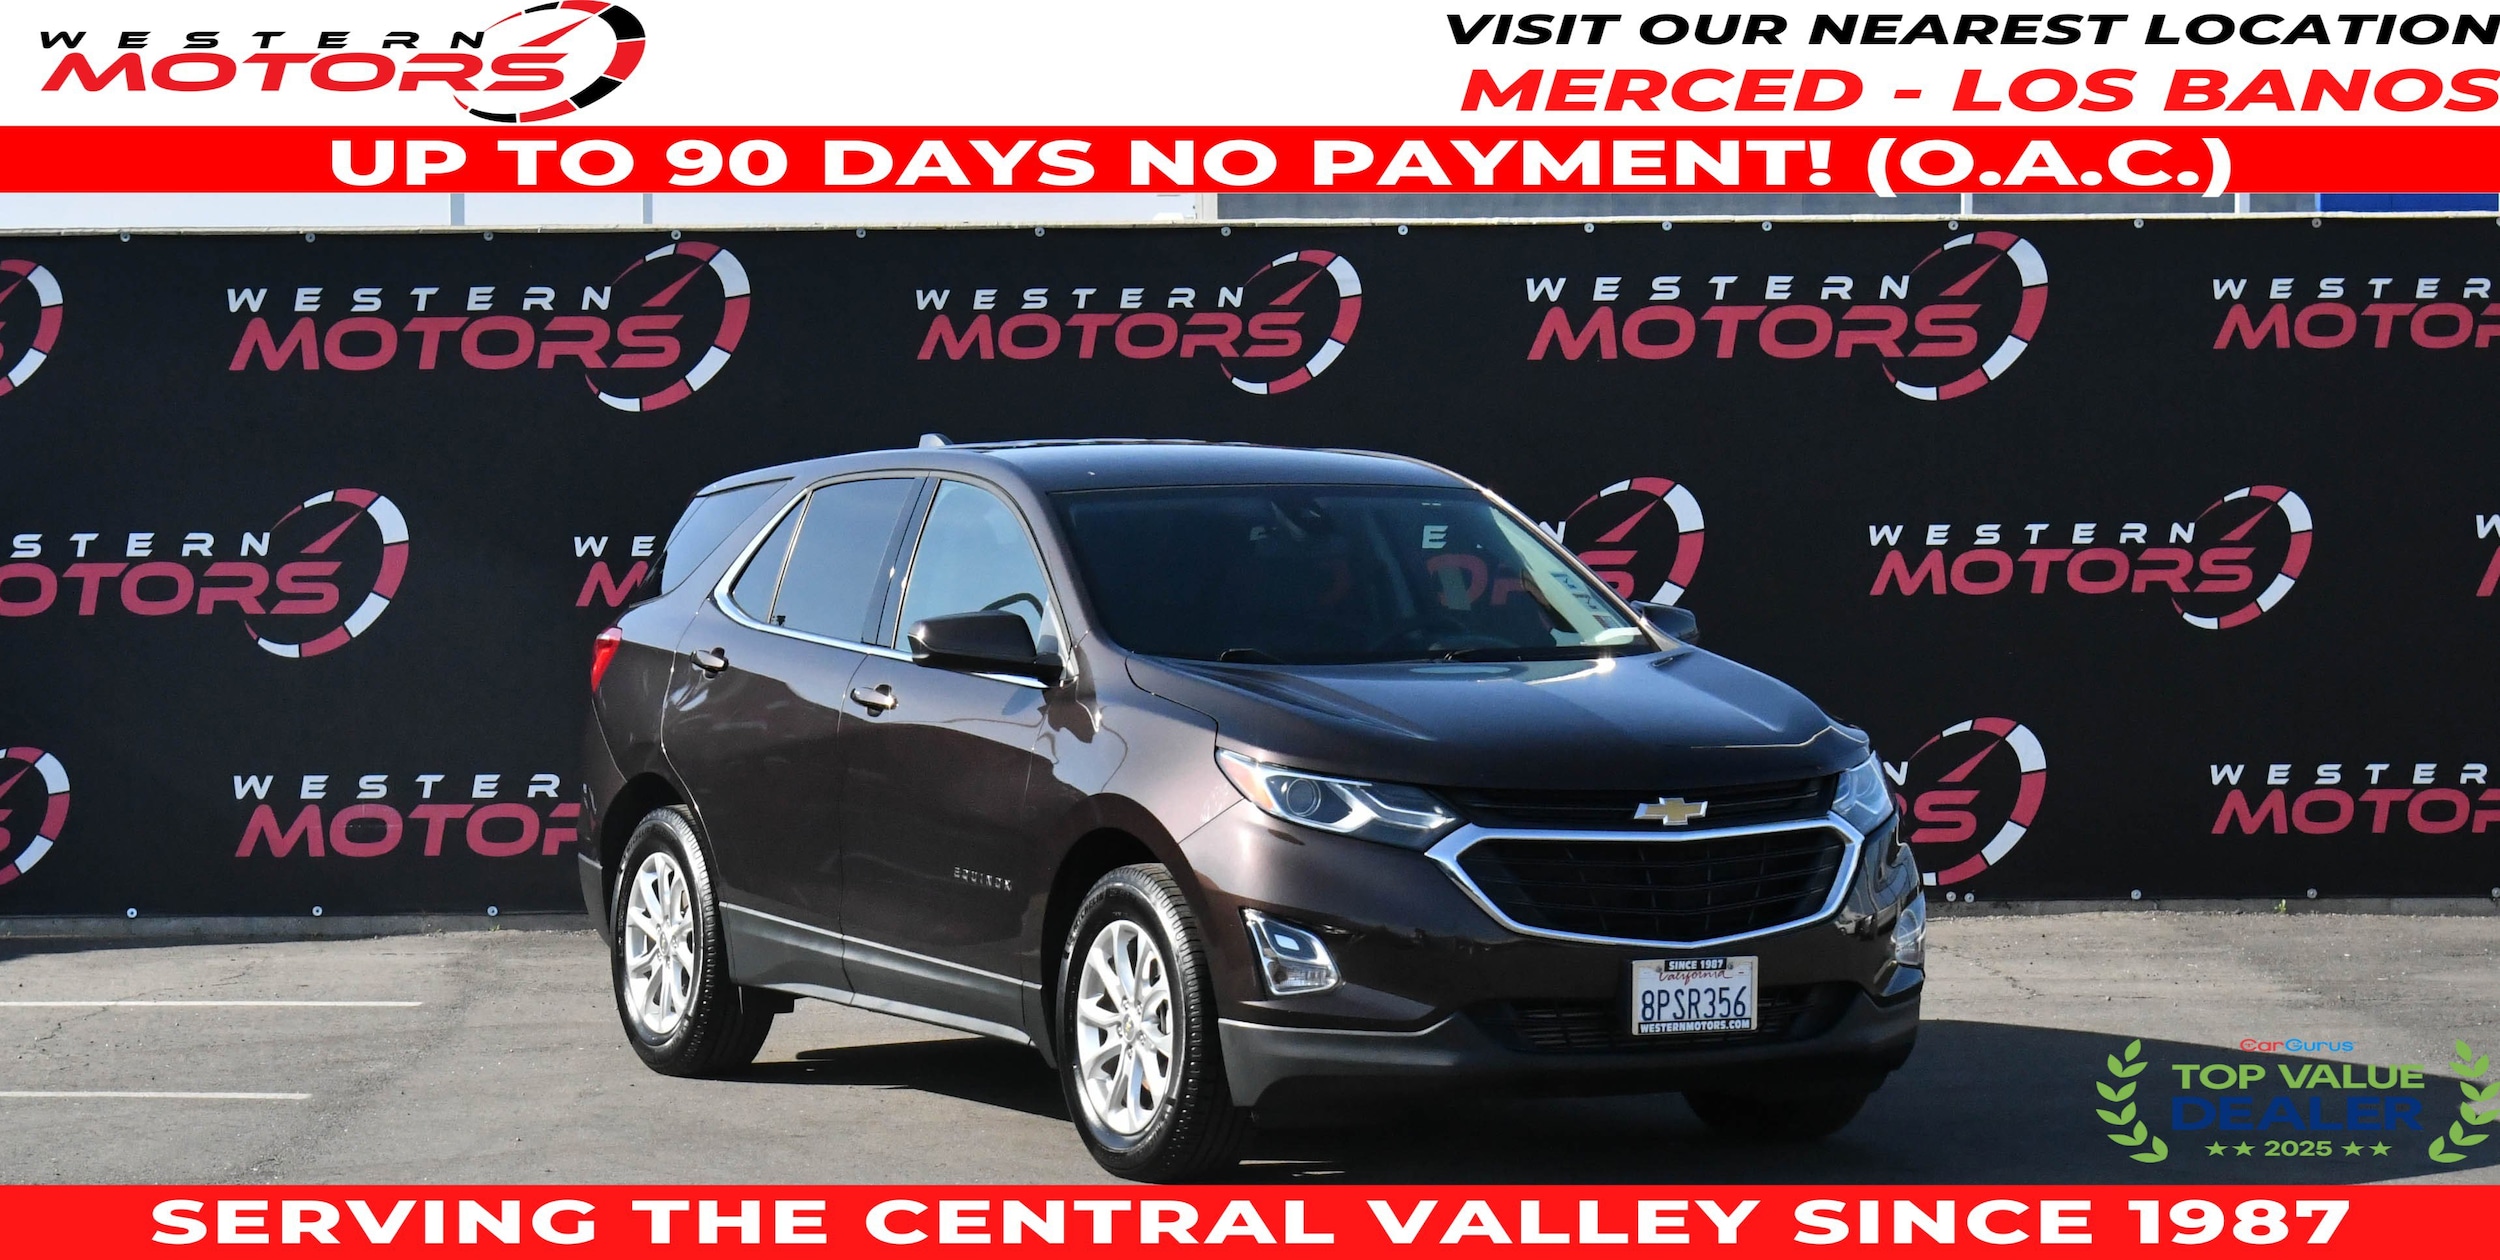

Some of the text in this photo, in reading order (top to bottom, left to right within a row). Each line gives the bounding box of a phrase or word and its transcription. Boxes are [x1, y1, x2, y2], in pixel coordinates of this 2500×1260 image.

[227, 285, 613, 313] WESTERN
[916, 285, 1245, 311] WESTERN
[1525, 275, 1910, 304] WESTERN
[2212, 276, 2492, 301] WESTER
[917, 312, 1305, 361] MOTORS
[1527, 304, 1981, 361] MOTORS
[2213, 302, 2500, 351] MOTO
[229, 315, 683, 371] MOTORS
[10, 531, 272, 558] STERN
[1868, 522, 2195, 546] WESTERN
[1870, 547, 2255, 596] MOTORS
[0, 560, 341, 617] OTORS
[233, 773, 561, 800] WESTER
[2210, 763, 2489, 786] WESTER
[2211, 788, 2500, 835] MOTO
[235, 802, 581, 858] MOTO
[953, 866, 1012, 892] EQUINOX
[1668, 959, 1724, 970] SINCE 1987
[1641, 985, 1747, 1021] 8PSR356
[1640, 1019, 1750, 1033] WESTERNMOTORS.COM
